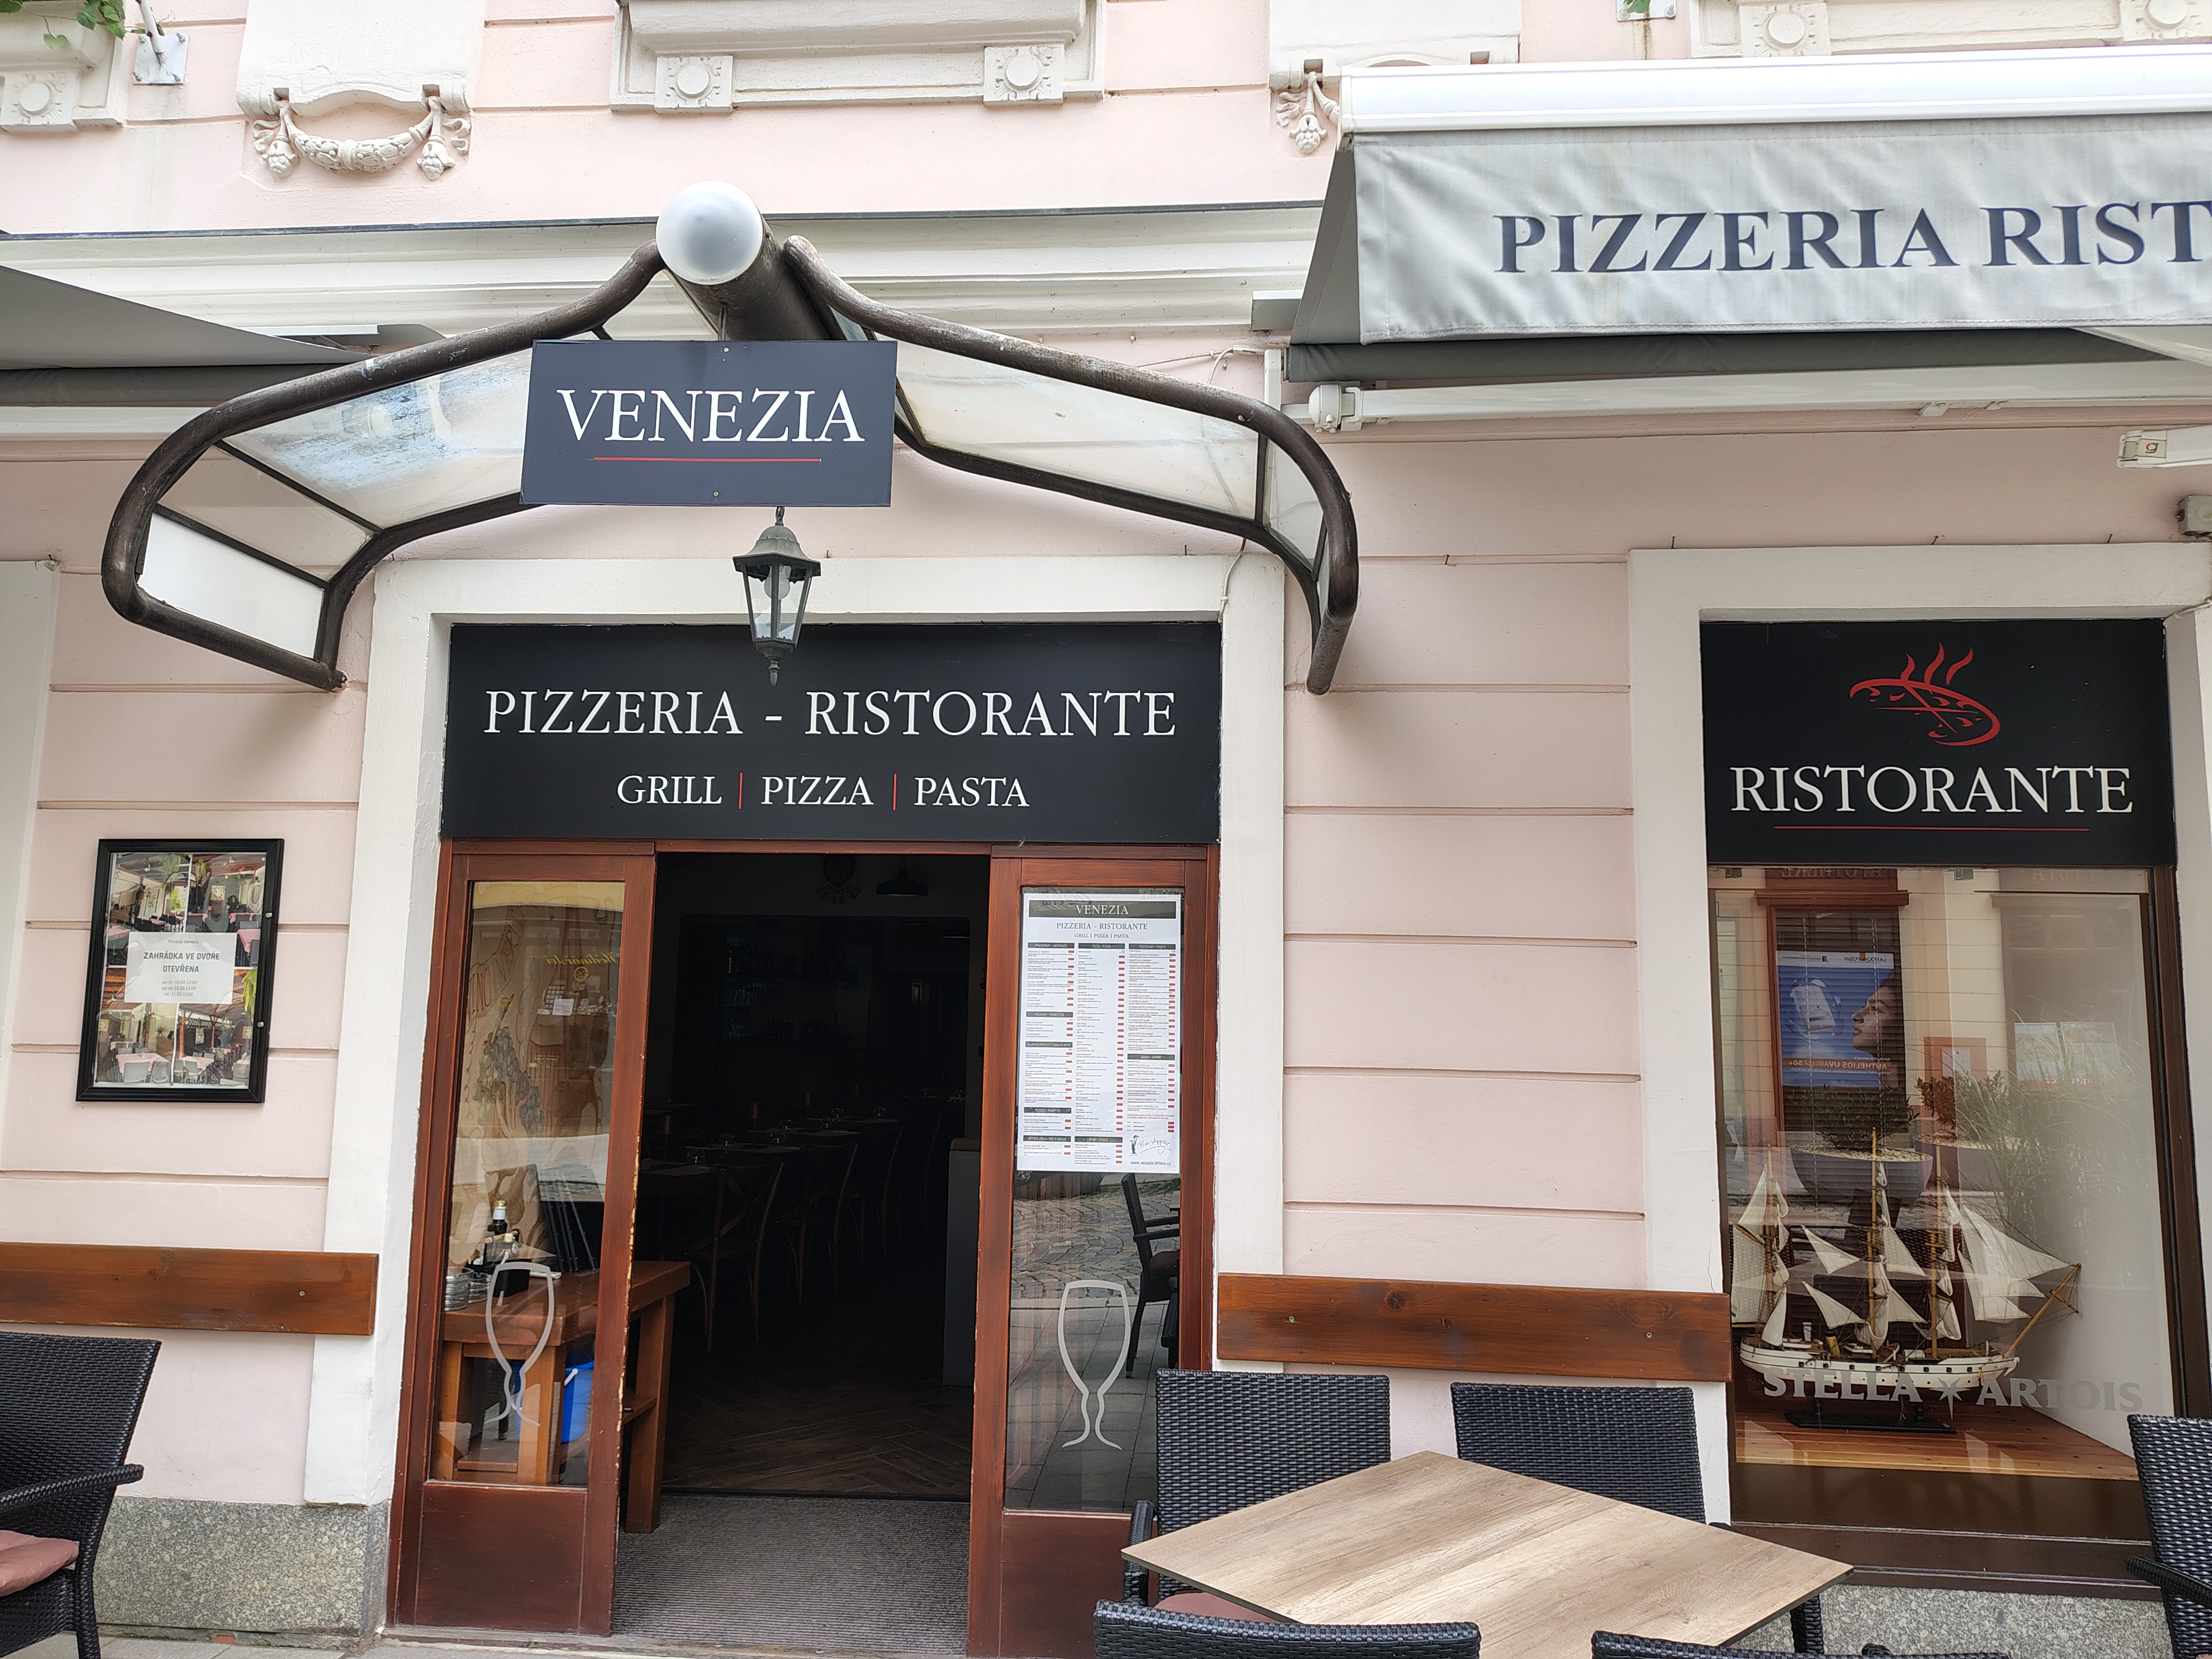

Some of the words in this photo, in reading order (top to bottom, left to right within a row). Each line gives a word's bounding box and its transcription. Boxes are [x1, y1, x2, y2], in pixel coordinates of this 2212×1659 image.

[1496, 208, 1957, 273] PIZZERIA
[557, 388, 865, 442] VENEZIA
[484, 689, 743, 736] PIZZERIA
[805, 690, 1175, 738] RISTORANTE
[617, 774, 722, 804] GRILL
[760, 775, 874, 805] PIZZA
[913, 776, 1030, 807] PASTA
[1730, 765, 2133, 814] RISTORANTE
[1056, 922, 1091, 930] PIZZERIA
[1075, 904, 1129, 915] VENEZIA
[143, 950, 184, 960] ZAHRÁDKA
[197, 950, 220, 960] DVOŘE
[163, 963, 199, 973] OTEVŘENA
[1763, 1368, 1923, 1402] STELLA
[1976, 1375, 2143, 1413] ARTOIS
